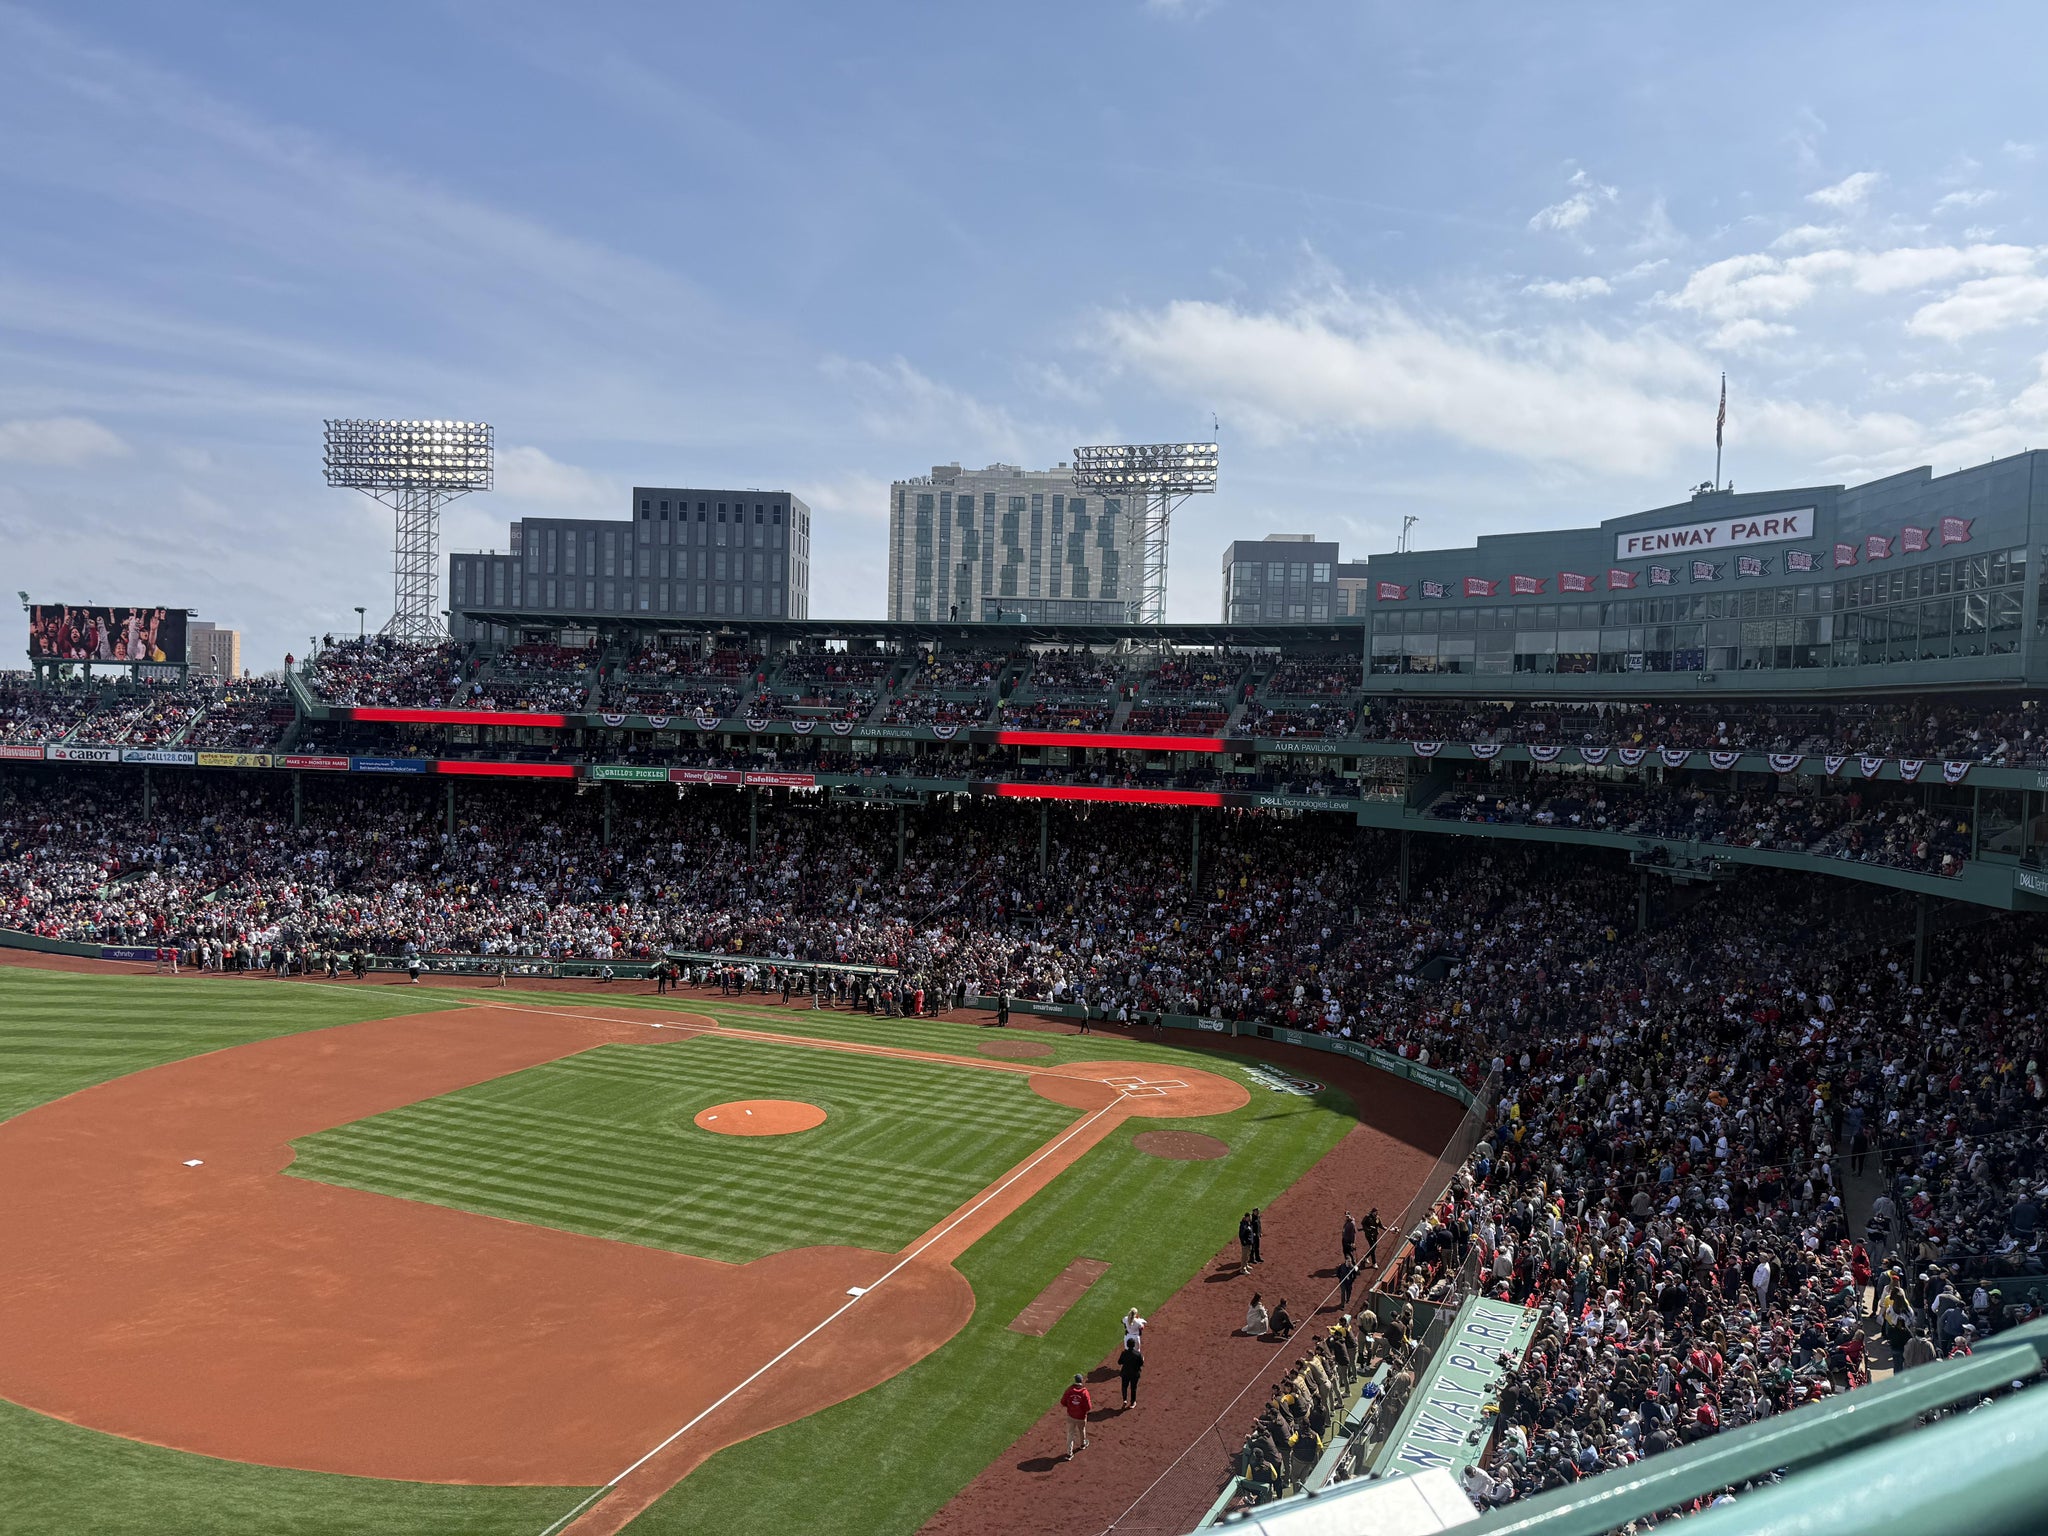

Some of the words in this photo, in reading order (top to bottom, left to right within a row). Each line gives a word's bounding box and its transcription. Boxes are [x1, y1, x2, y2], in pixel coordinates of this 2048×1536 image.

[1627, 527, 1717, 553] FENWAY
[1731, 516, 1798, 540] PARK
[1301, 744, 1336, 752] PAVILION
[147, 751, 193, 762] CALL128.COM
[684, 772, 703, 780] Ninety
[746, 775, 780, 784] Safelite
[1260, 797, 1282, 806] DELL
[1282, 799, 1329, 810] Technologies
[1330, 801, 1349, 810] Level
[2019, 873, 2035, 889] DELL
[113, 950, 135, 958] xfinity
[1032, 1004, 1064, 1013] smartwater
[1375, 1055, 1395, 1069] National
[1447, 1305, 1519, 1377] PARK
